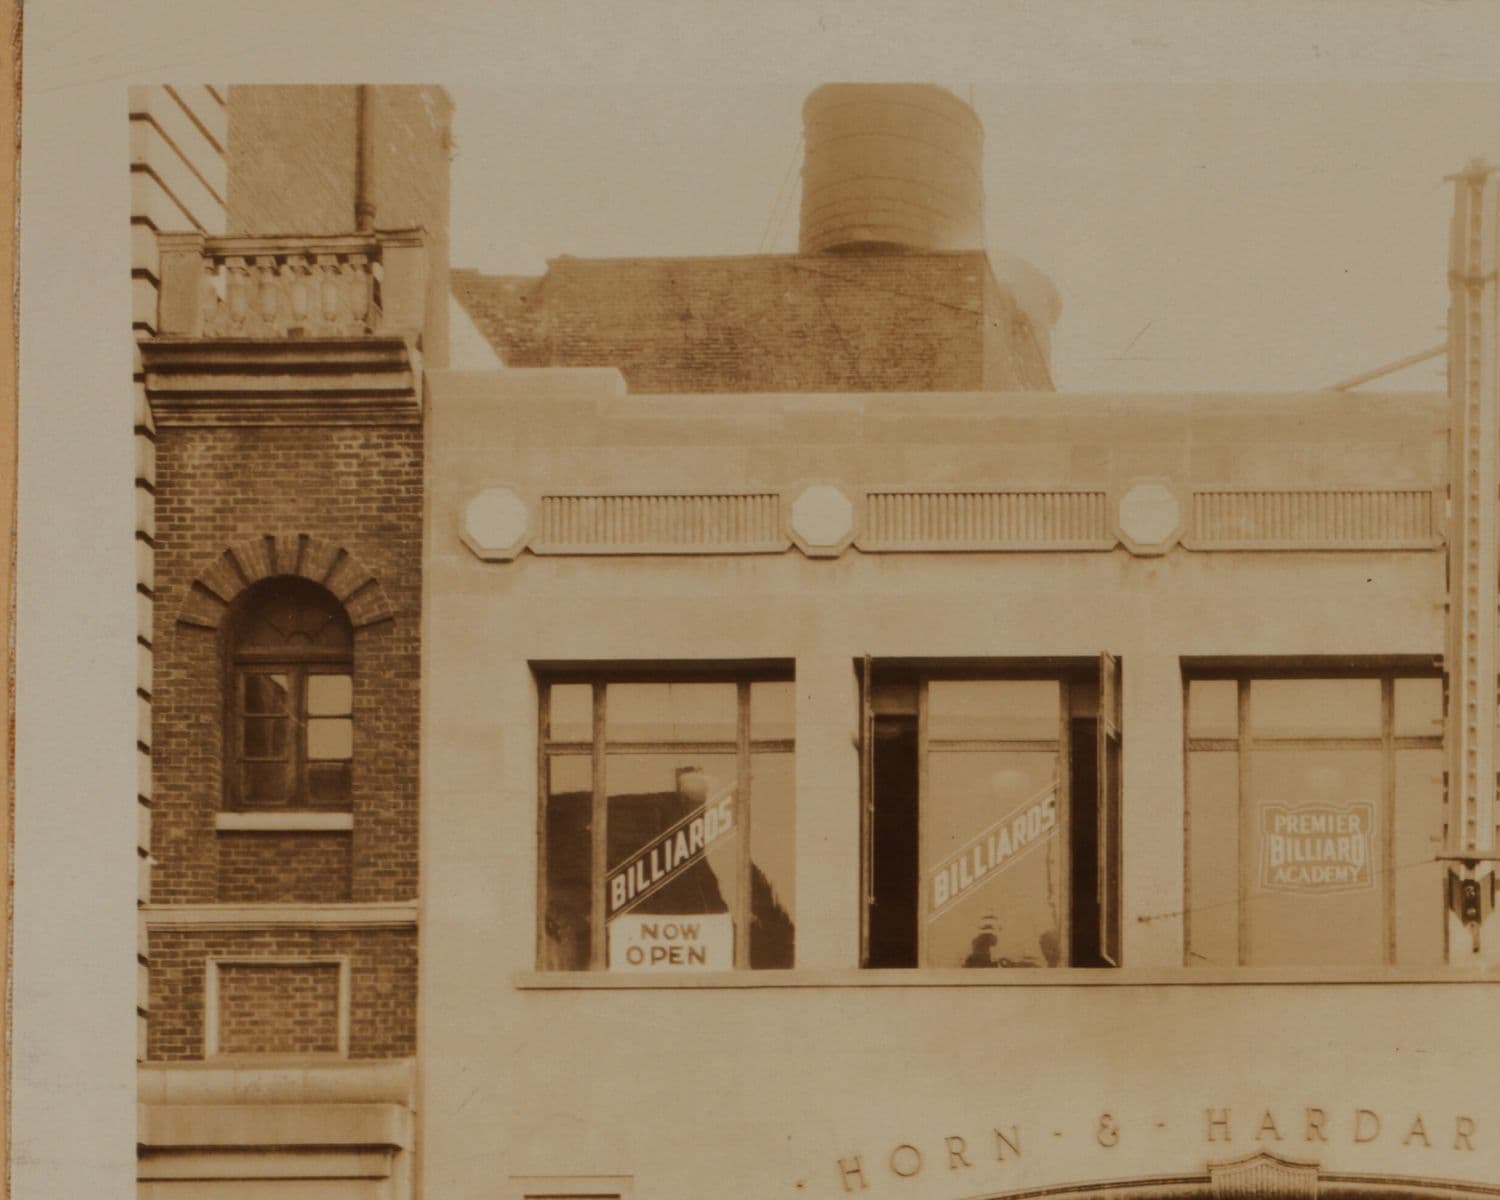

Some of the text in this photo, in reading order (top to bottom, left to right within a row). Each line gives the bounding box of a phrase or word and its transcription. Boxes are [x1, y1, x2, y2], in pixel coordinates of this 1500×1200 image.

[1275, 814, 1361, 834] PREMIER
[611, 795, 733, 911] BILLIARDS
[934, 793, 1056, 909] BILLIARDS
[1270, 833, 1364, 866] BILLIARD
[1274, 864, 1361, 883] ACADEMY
[641, 923, 701, 941] NOW
[626, 945, 706, 966] OPEN
[837, 1124, 1022, 1193] HORN
[1096, 1113, 1120, 1148] &
